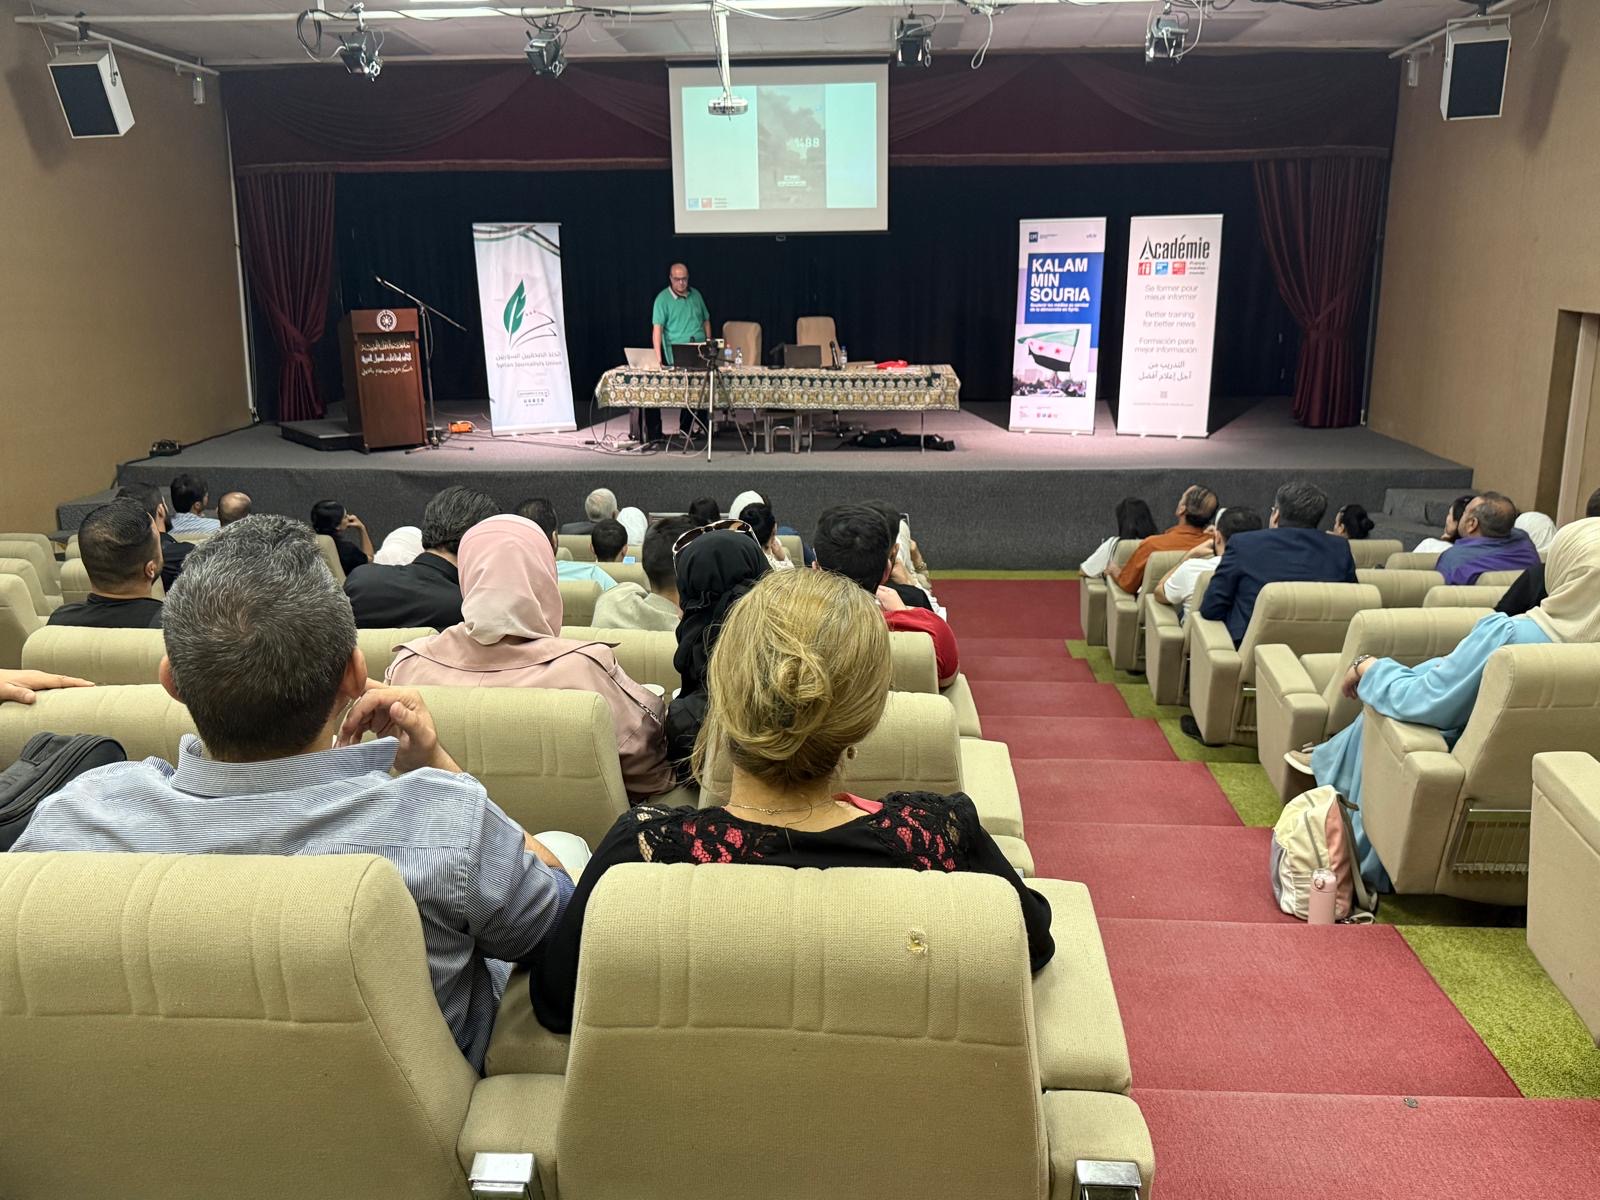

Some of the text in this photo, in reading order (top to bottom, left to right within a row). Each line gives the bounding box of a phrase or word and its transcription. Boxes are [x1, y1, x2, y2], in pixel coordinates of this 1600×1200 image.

[1139, 235, 1210, 260] Académie
[1032, 258, 1088, 272] KALAM
[1030, 273, 1060, 287] MIN
[1156, 284, 1180, 292] former
[1181, 284, 1199, 293] pour
[1030, 287, 1091, 302] SOURIA
[1167, 293, 1198, 301] informer
[1145, 310, 1195, 319] Better training
[1143, 320, 1152, 328] for
[1153, 320, 1175, 328] better
[1139, 337, 1195, 346] Formación para
